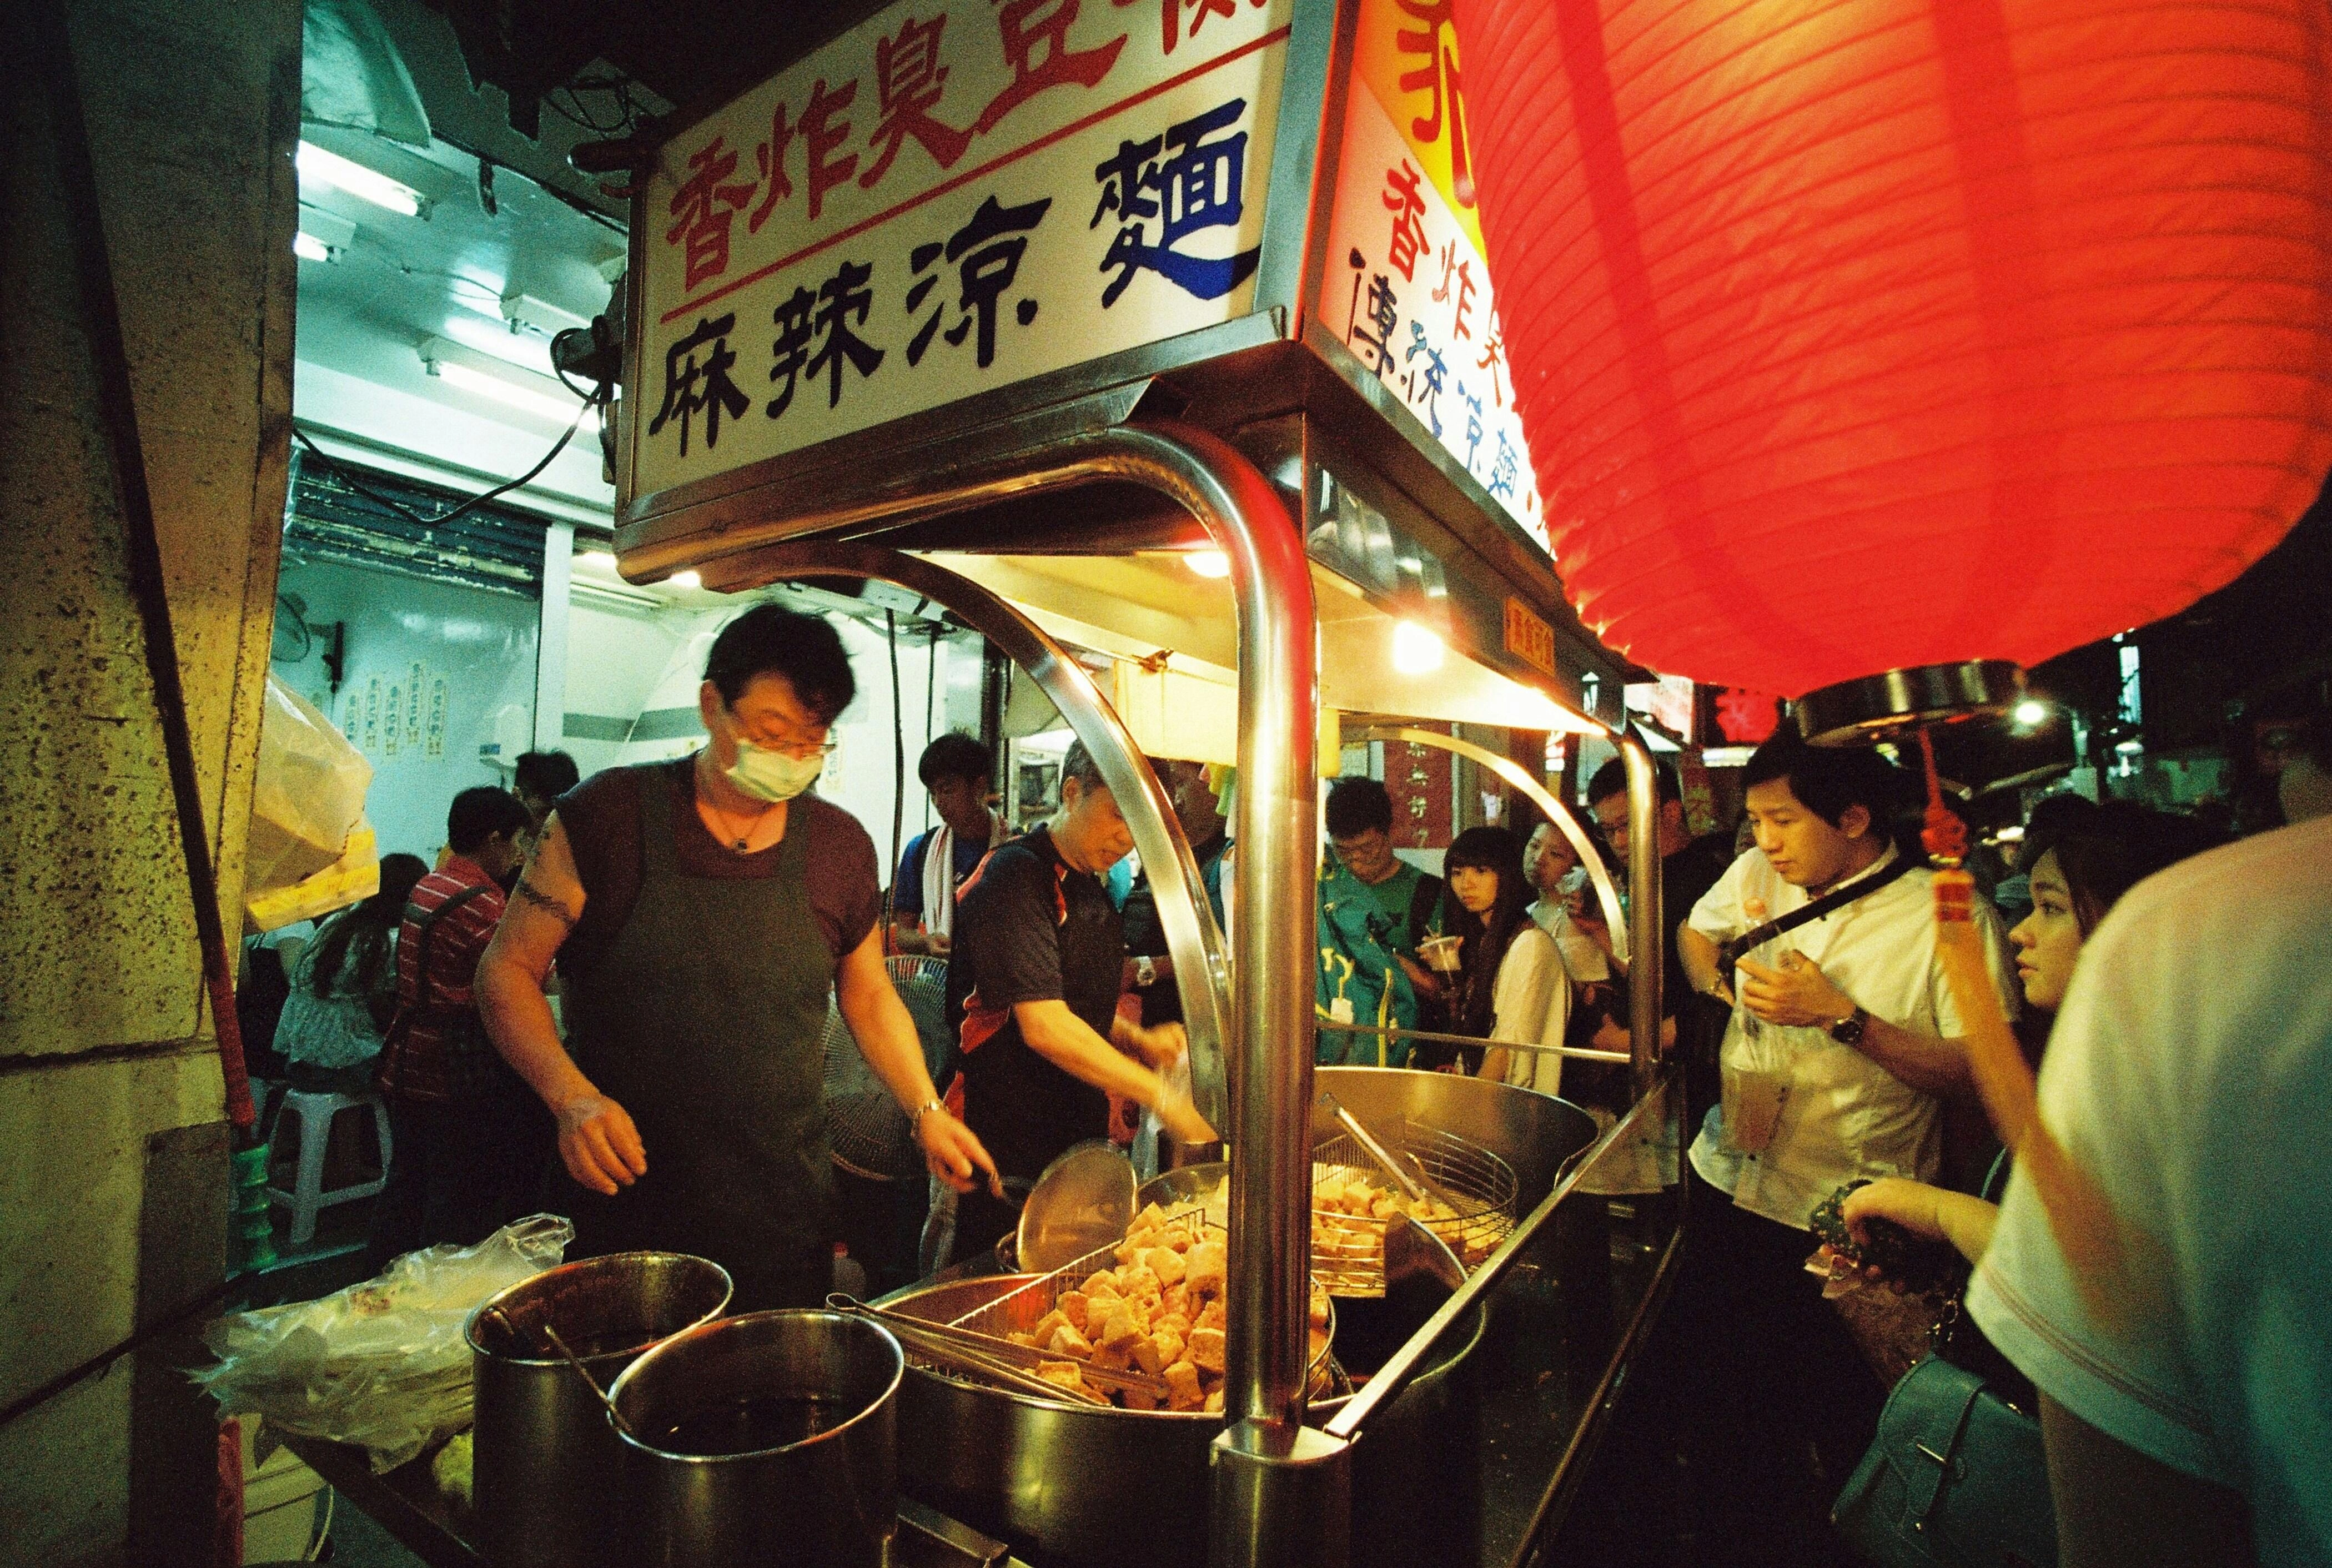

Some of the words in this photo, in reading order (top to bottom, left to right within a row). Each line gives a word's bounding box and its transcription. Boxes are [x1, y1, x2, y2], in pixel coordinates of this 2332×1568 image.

[649, 98, 1262, 457] 麻辣涼麵
[667, 0, 1266, 293] 香炸臭豆
[1349, 247, 1518, 499] 傳統涼麵
